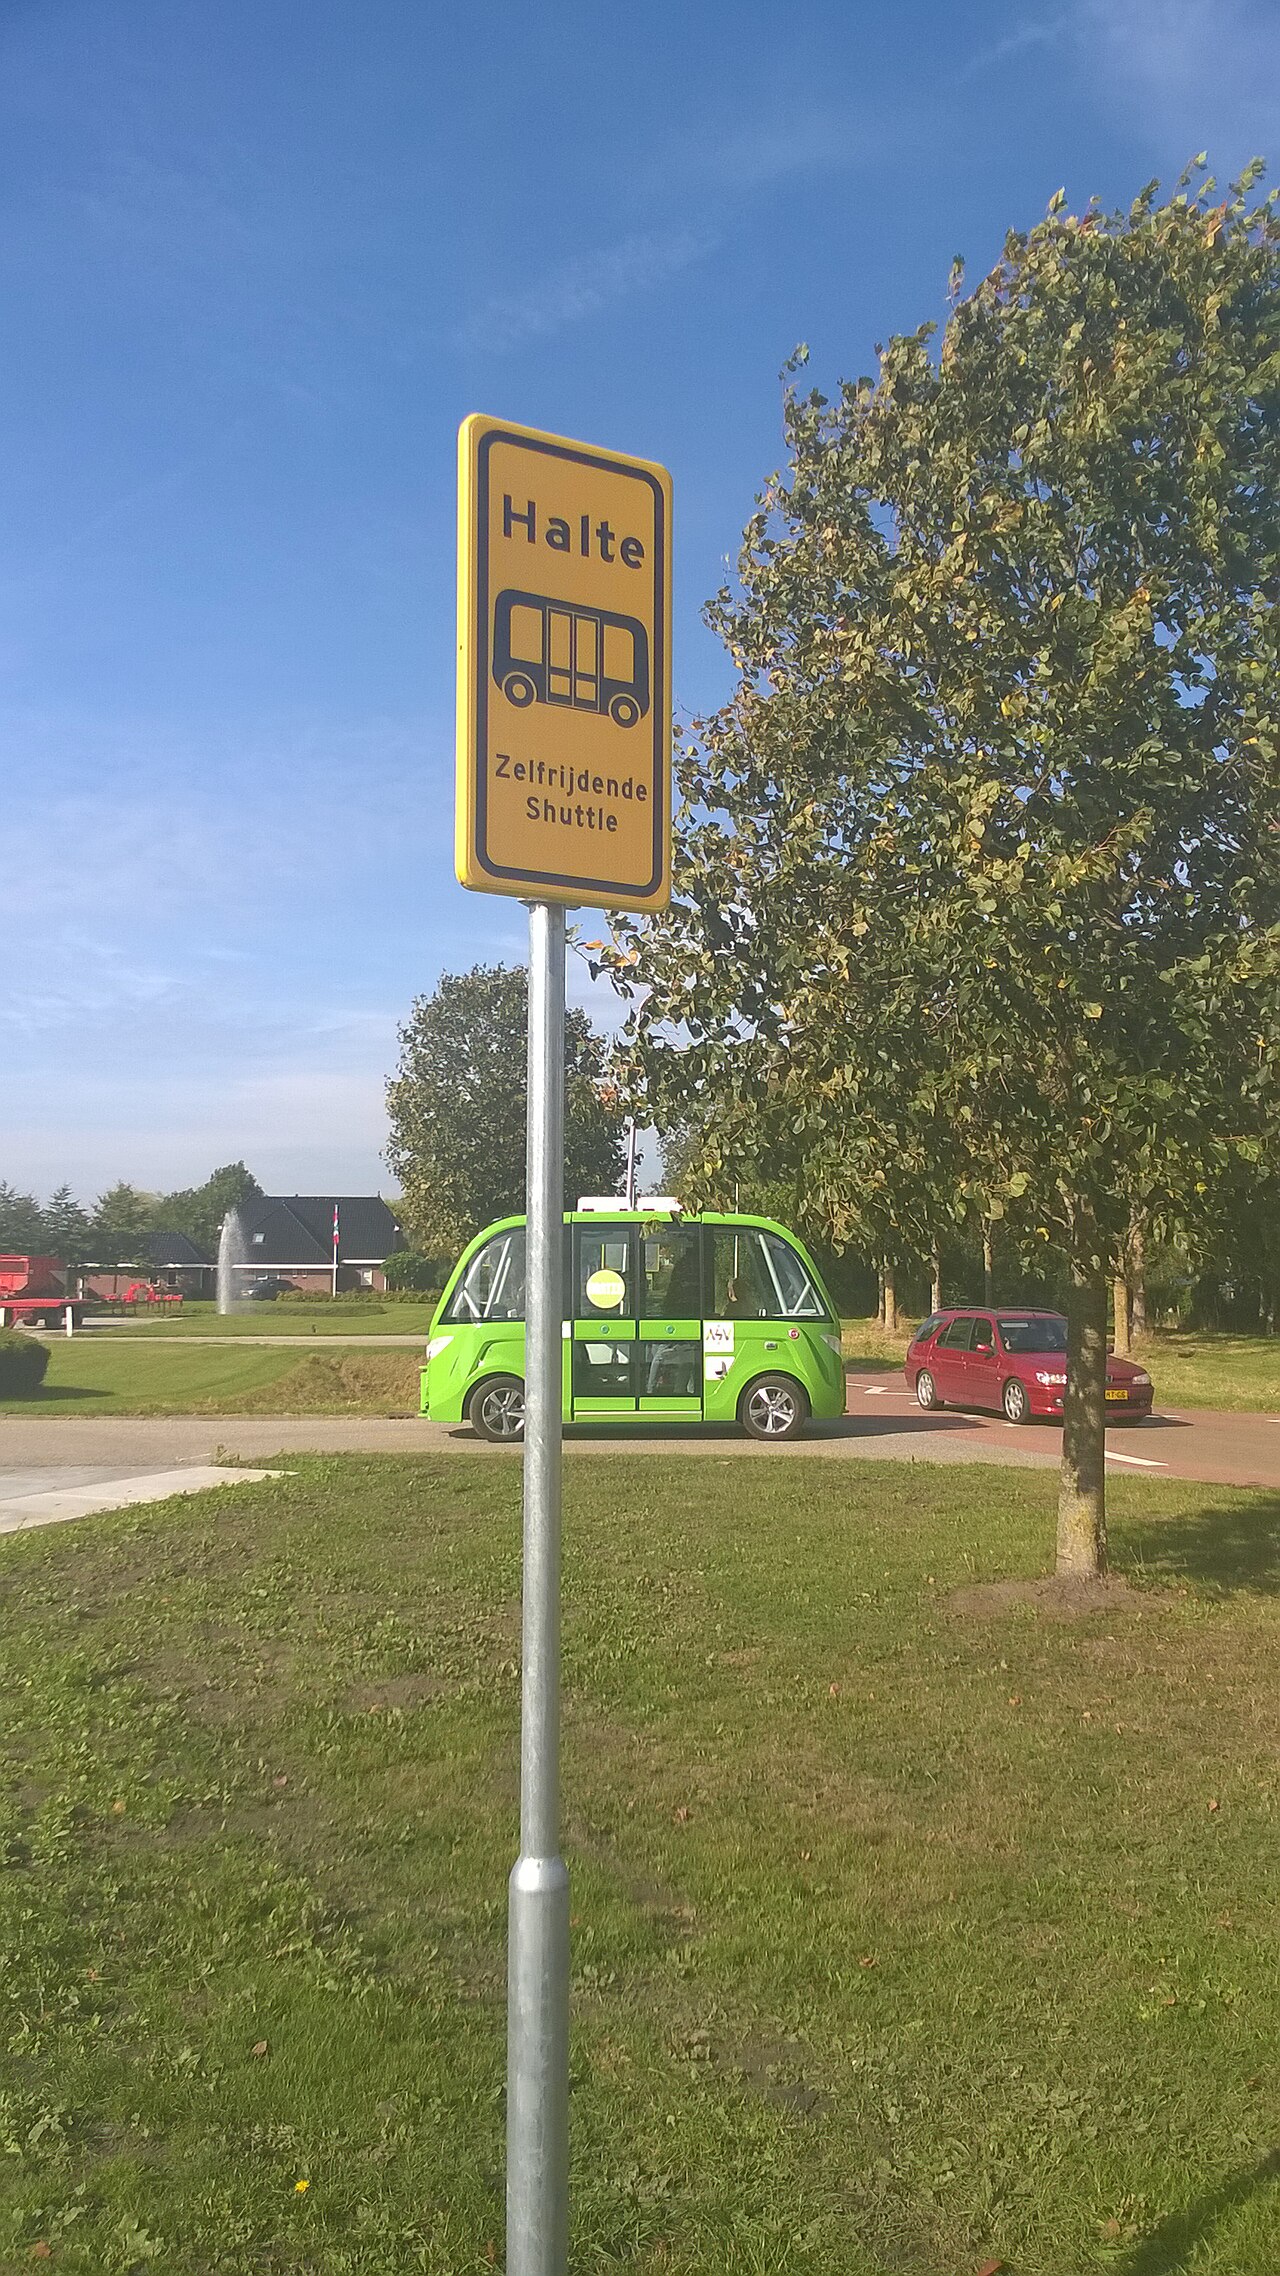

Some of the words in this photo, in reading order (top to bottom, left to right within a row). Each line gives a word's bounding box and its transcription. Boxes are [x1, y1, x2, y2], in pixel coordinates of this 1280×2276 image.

[503, 493, 645, 569] Halte
[495, 753, 648, 801] Zelfrijdende
[526, 796, 618, 832] Shuttle
